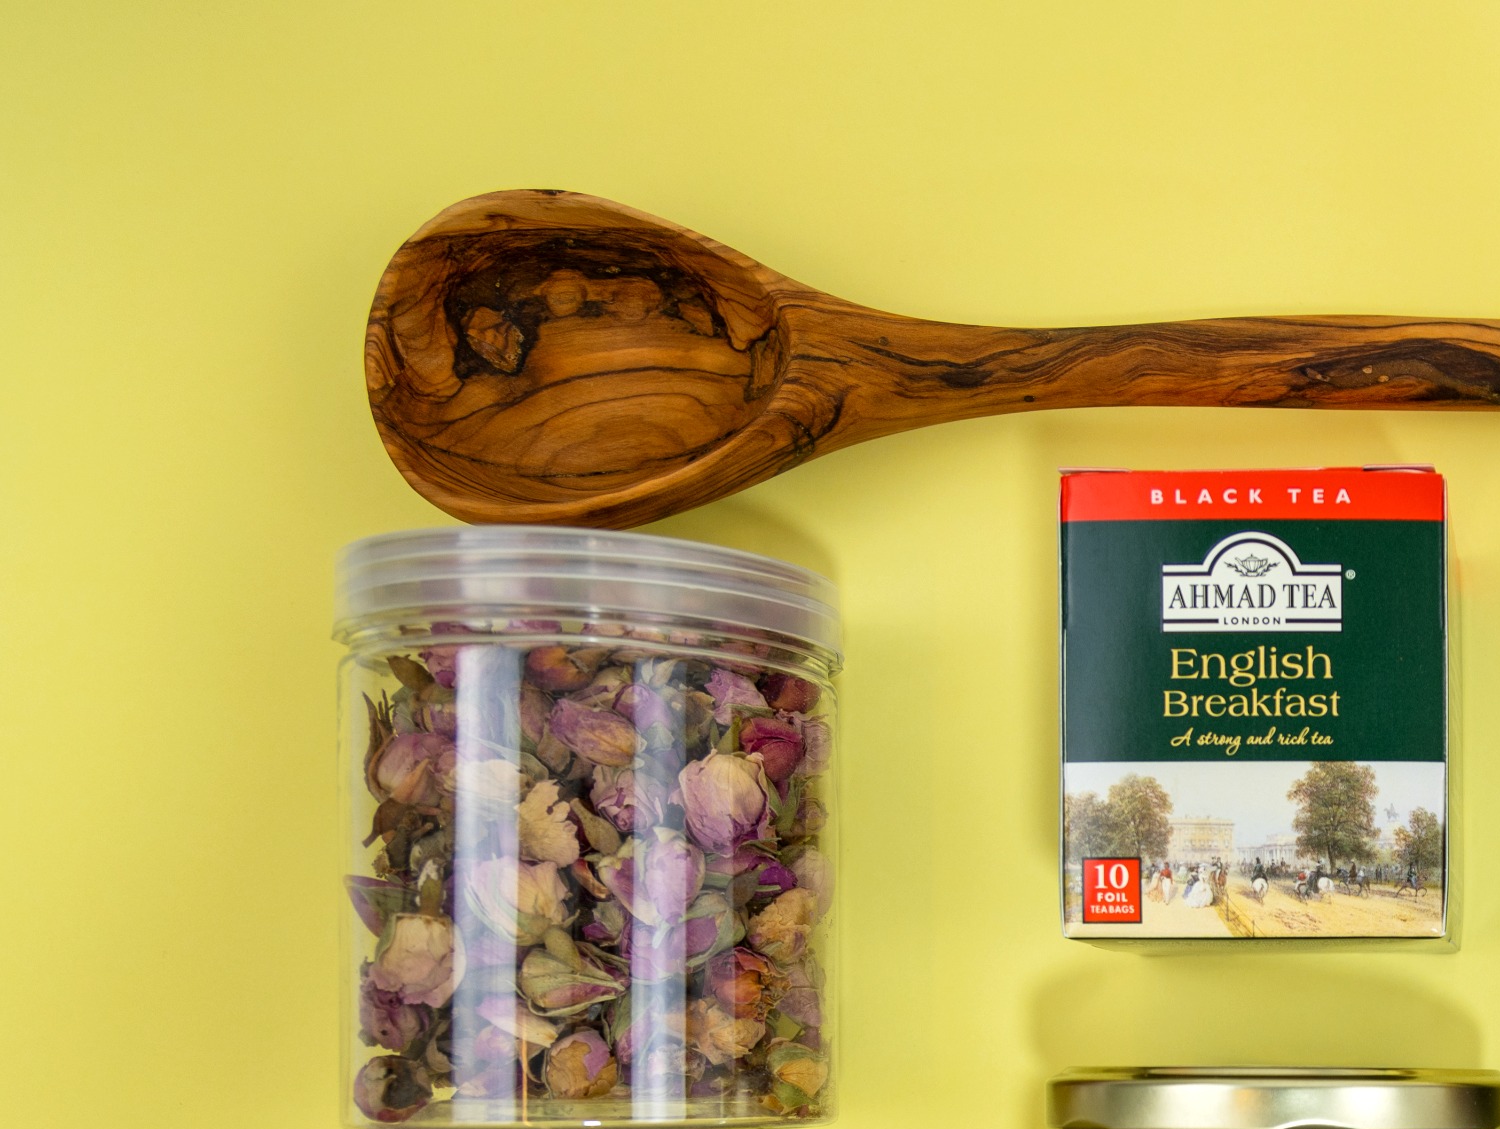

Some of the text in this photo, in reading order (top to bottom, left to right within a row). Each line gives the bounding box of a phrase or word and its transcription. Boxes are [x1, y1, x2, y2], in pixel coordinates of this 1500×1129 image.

[1151, 489, 1351, 505] BLACK TEA
[1169, 583, 1337, 609] AHMAD TEA
[1223, 617, 1281, 625] LONDON
[1170, 646, 1333, 687] English
[1163, 688, 1340, 717] Breakfast
[1171, 727, 1333, 755] A strong and rich tea
[1094, 863, 1129, 889] 10
[1097, 892, 1128, 903] FOIL
